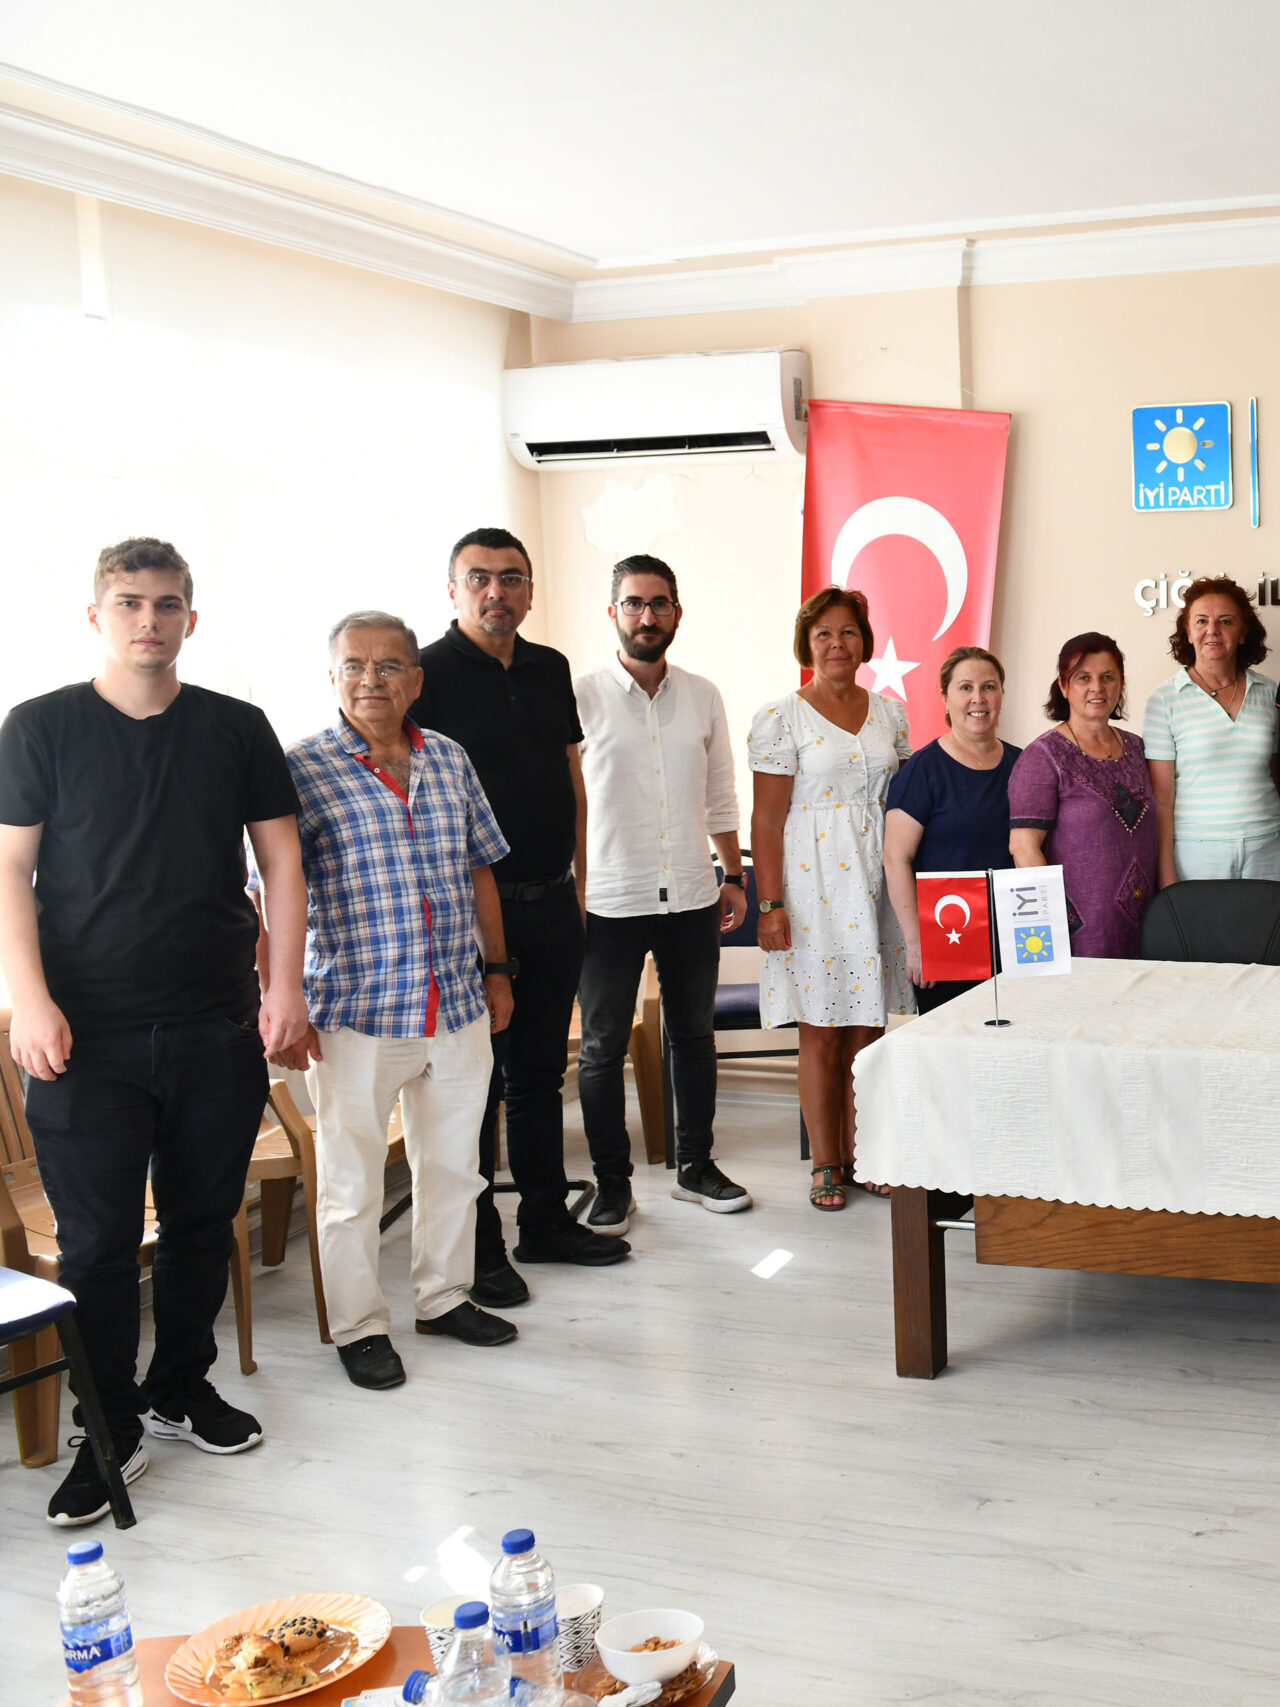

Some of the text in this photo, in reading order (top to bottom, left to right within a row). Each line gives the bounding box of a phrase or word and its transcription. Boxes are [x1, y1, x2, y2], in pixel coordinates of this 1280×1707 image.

[1139, 481, 1225, 507] İYİ PARTİ
[1134, 570, 1225, 617] ÇİĞ
